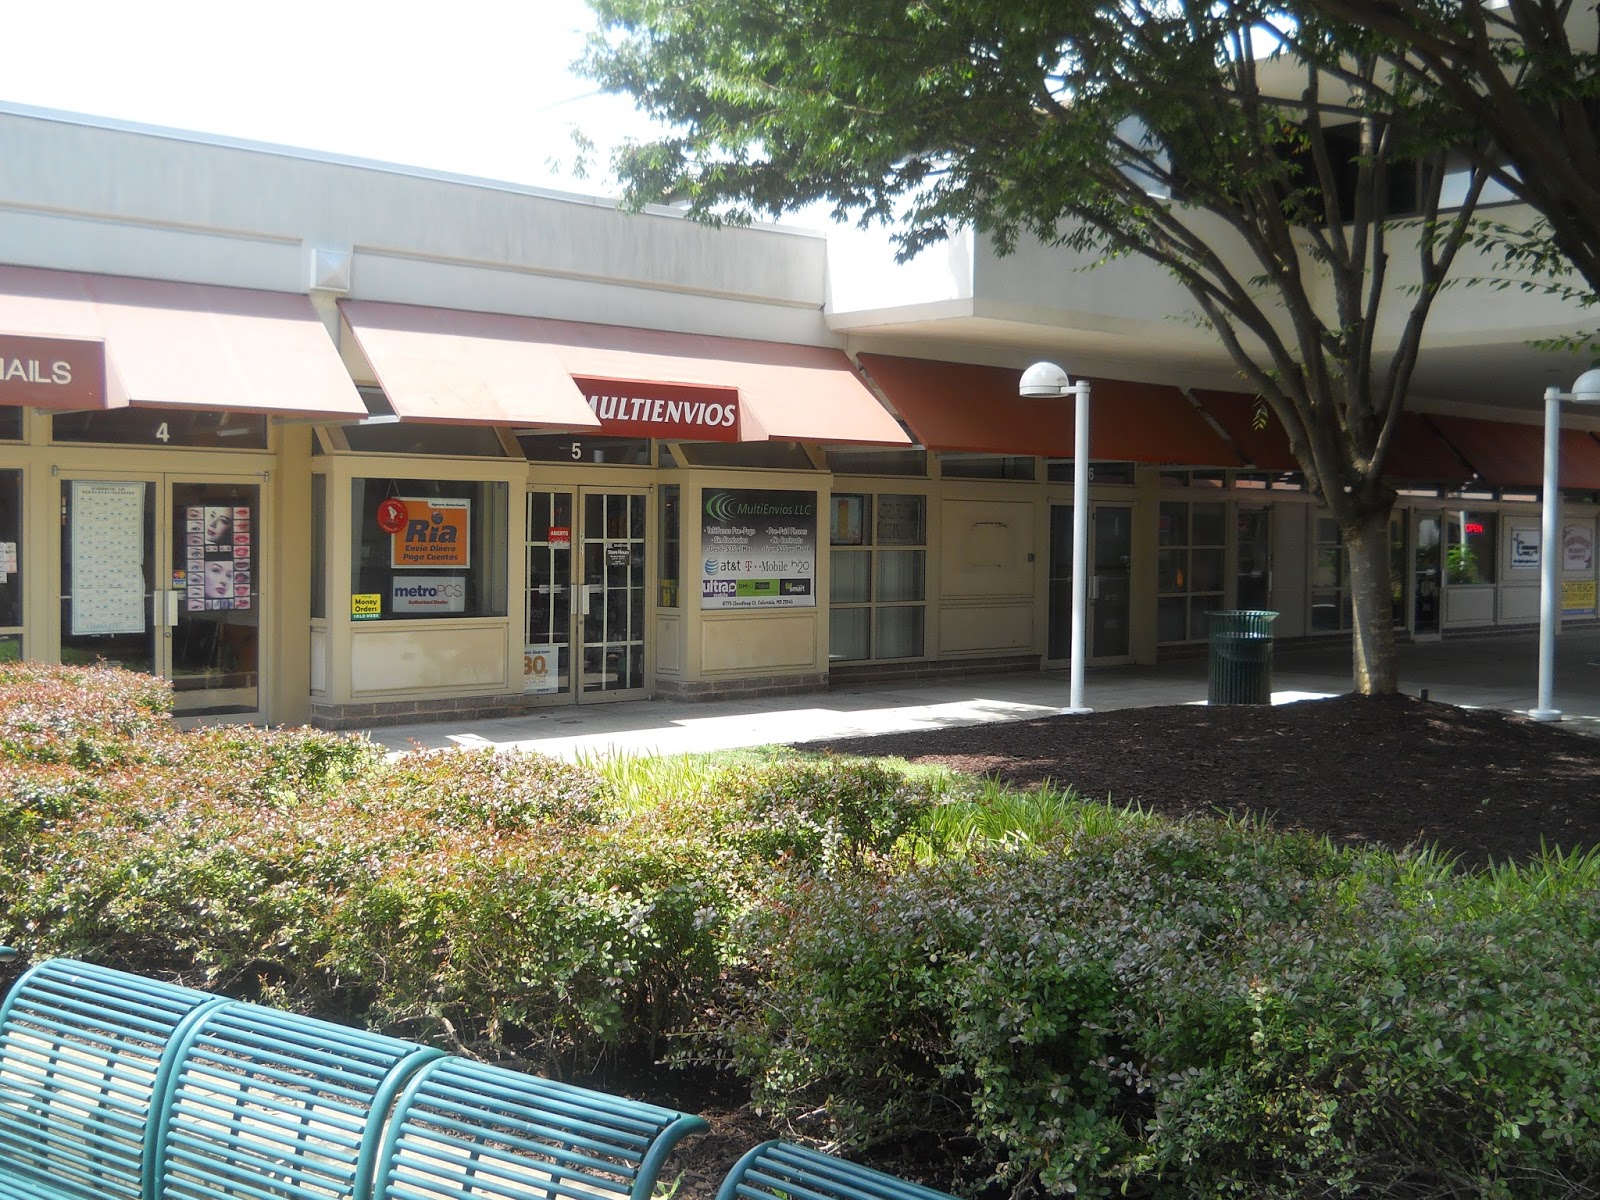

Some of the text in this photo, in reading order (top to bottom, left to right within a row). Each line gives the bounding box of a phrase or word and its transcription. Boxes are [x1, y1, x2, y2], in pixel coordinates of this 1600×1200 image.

[0, 357, 72, 385] AILS
[156, 421, 170, 443] 4
[571, 442, 582, 460] 5
[1088, 467, 1095, 481] 6
[737, 503, 811, 516] MultiEnvios LLC
[405, 512, 458, 543] Ria
[1465, 523, 1483, 533] OPEN
[402, 553, 459, 562] Paga Cuentas
[720, 560, 741, 571] at&t
[355, 599, 377, 607] Money
[355, 605, 377, 613] Orders
